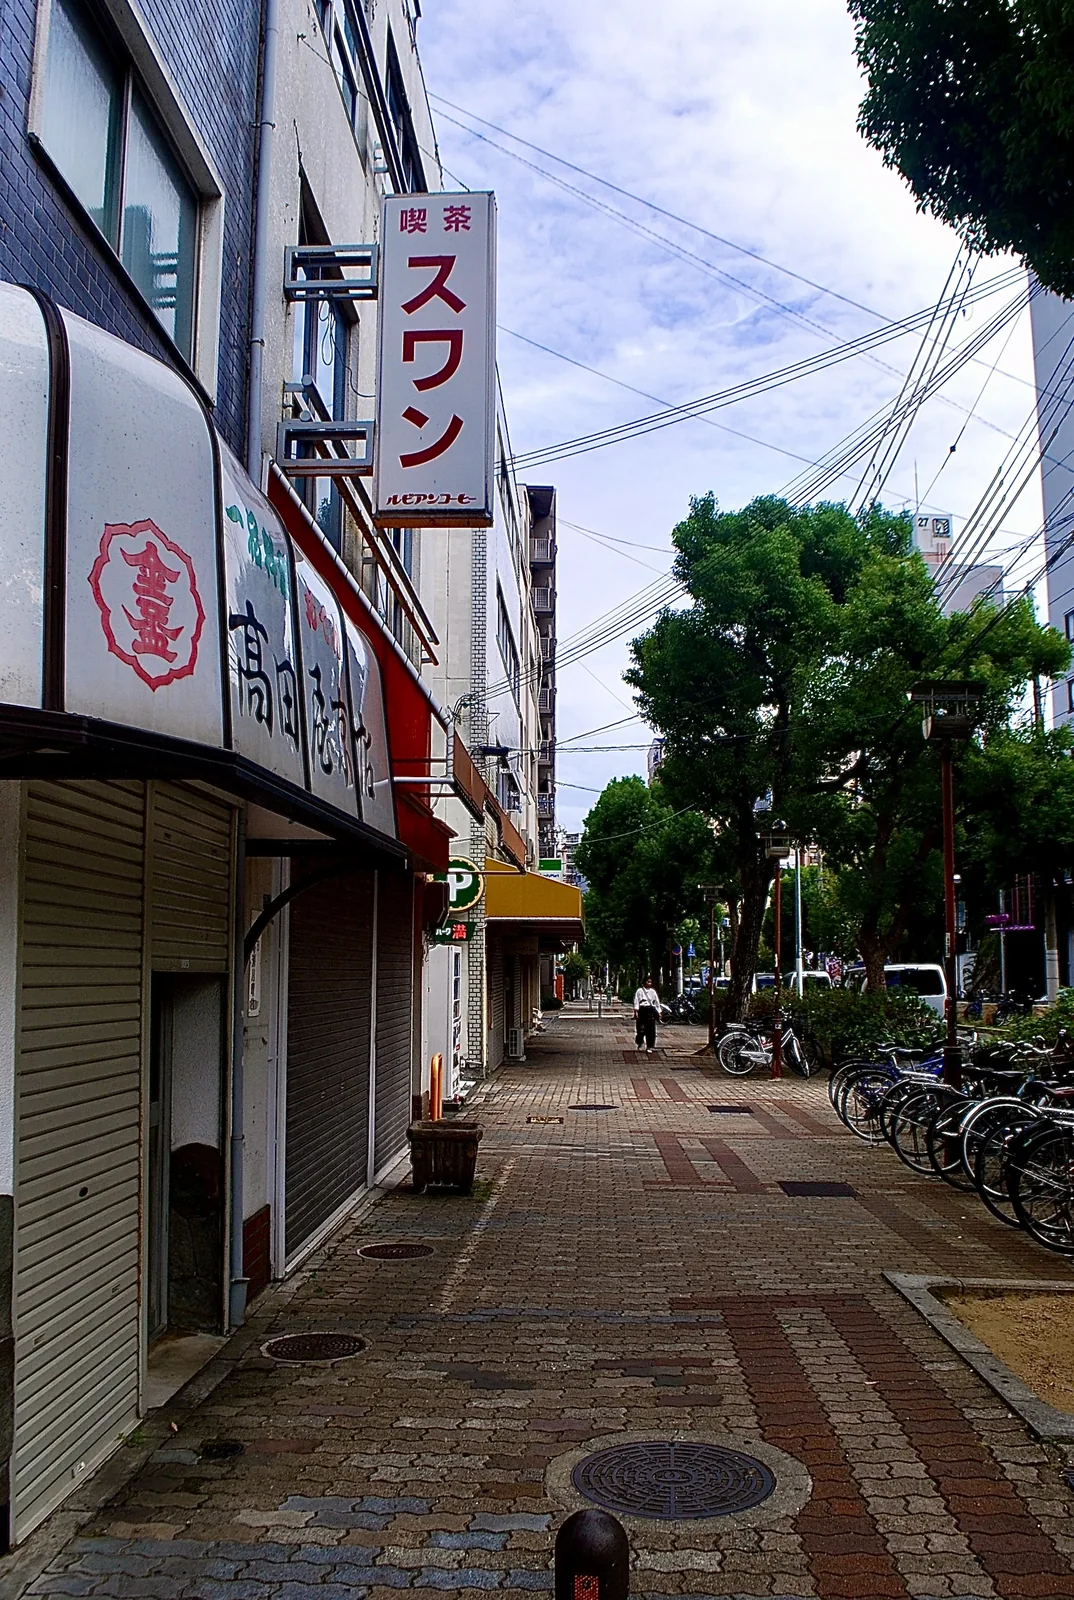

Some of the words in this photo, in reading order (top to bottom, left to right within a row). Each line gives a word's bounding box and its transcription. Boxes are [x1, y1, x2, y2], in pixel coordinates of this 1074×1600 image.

[399, 205, 471, 233] 喫茶
[399, 255, 467, 468] スワン
[918, 517, 929, 527] 27
[447, 868, 473, 901] P
[452, 924, 467, 939] 満
